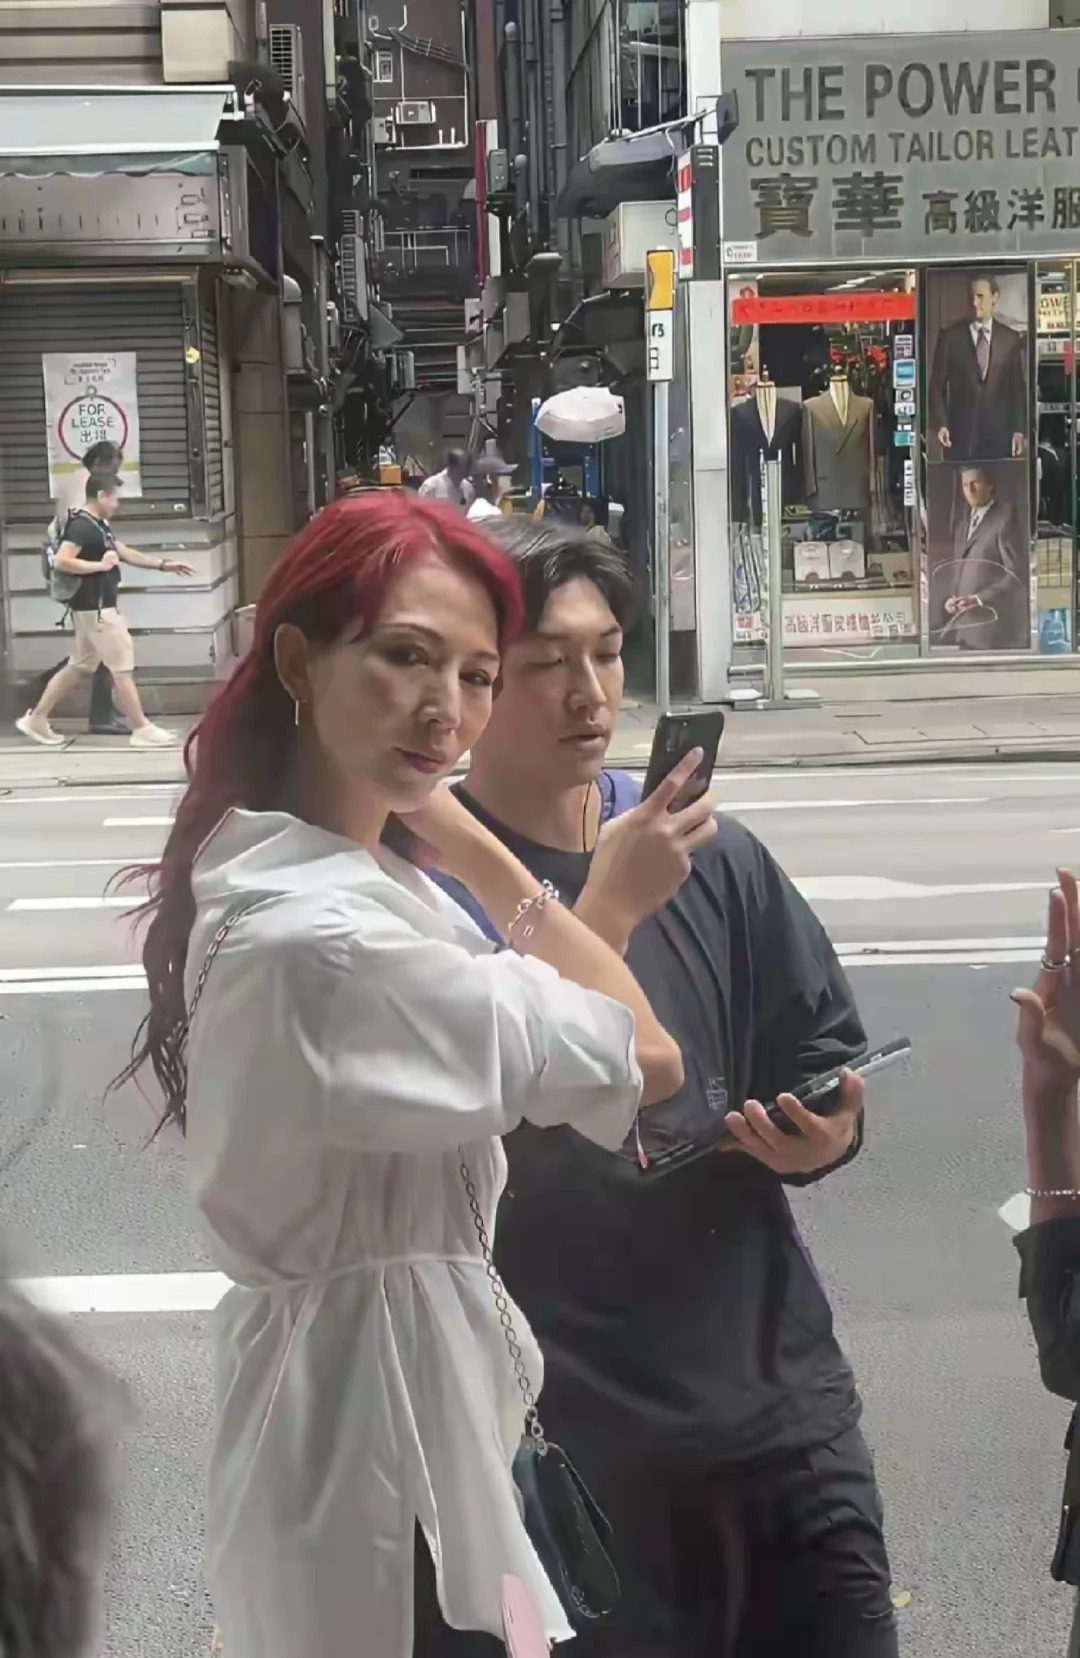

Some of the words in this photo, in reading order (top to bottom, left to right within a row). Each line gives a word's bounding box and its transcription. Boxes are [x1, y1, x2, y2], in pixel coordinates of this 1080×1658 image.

[745, 65, 845, 122] THE
[865, 59, 1056, 119] POWER
[745, 132, 877, 167] CUSTOM
[887, 129, 994, 163] TAILOR
[1006, 126, 1079, 159] LEAT
[750, 171, 904, 239] 寶華
[71, 417, 115, 429] LEASE
[78, 403, 105, 416] FOR
